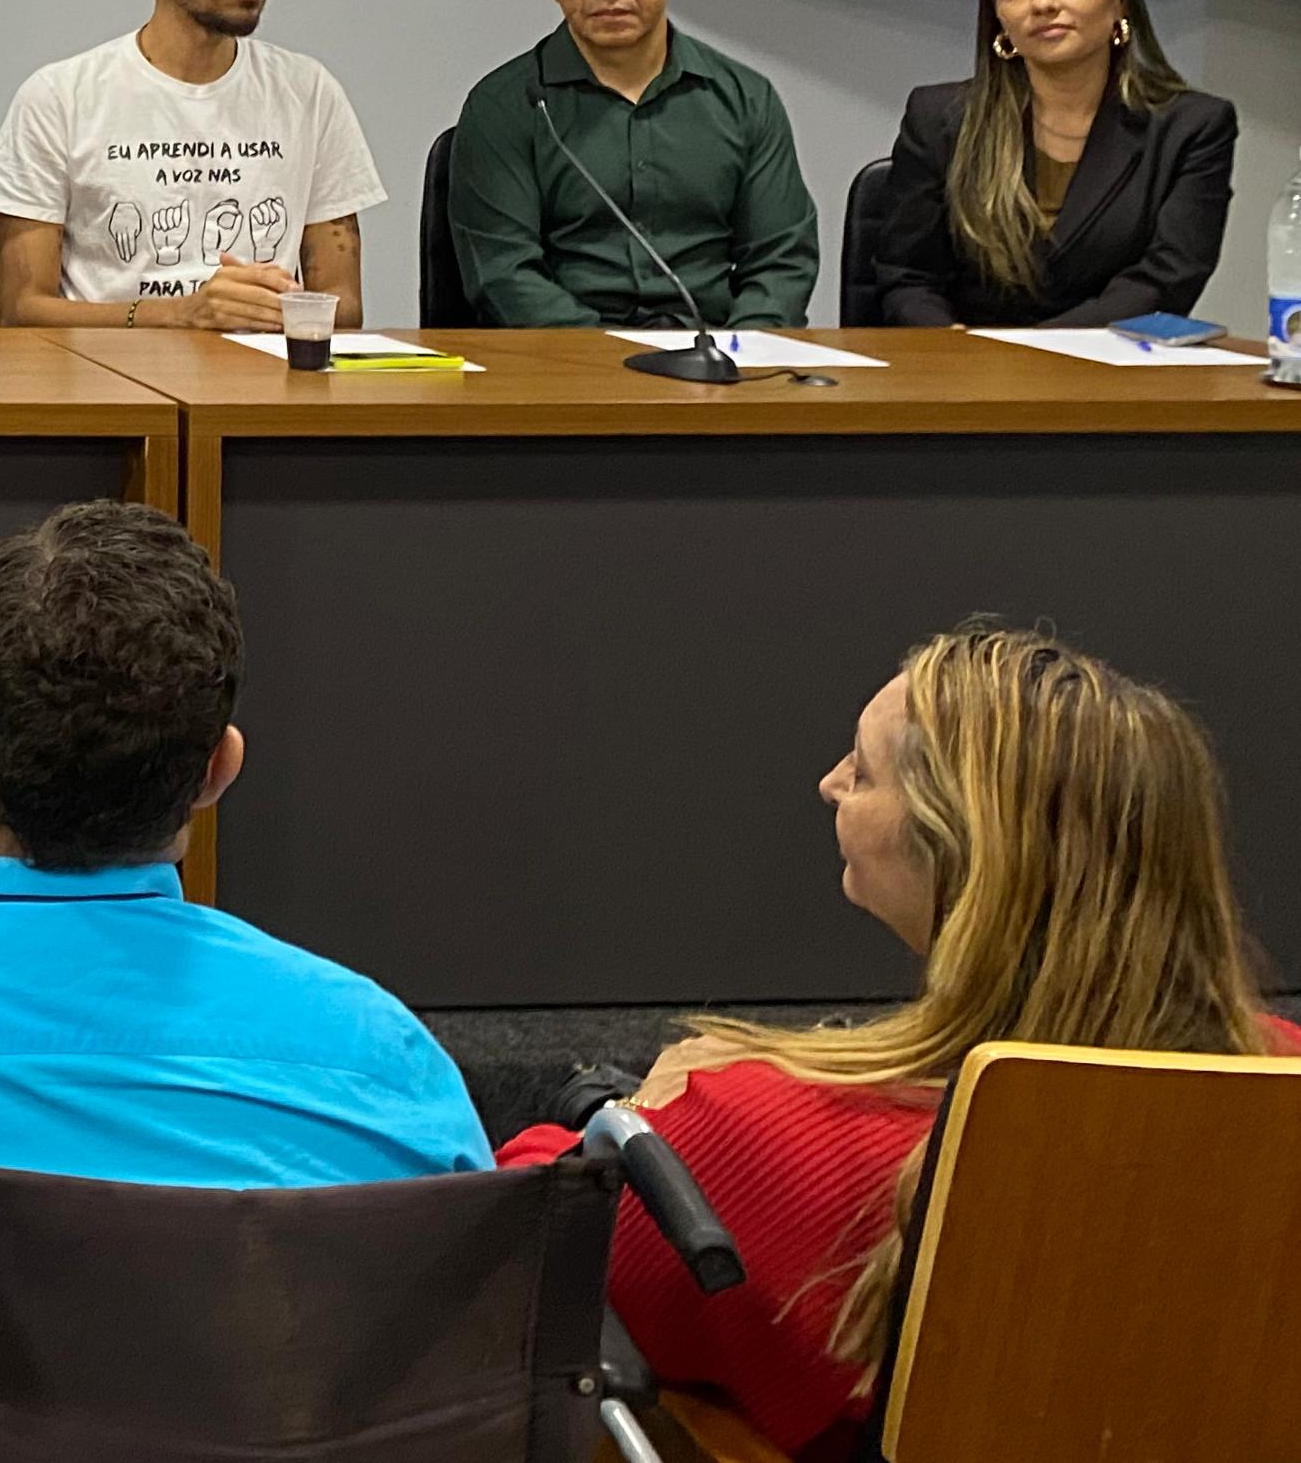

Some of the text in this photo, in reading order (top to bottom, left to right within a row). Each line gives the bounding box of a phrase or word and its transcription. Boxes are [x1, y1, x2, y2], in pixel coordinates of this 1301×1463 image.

[107, 141, 284, 161] EU APRENDI A USAR
[156, 168, 242, 186] A VOZ NAS
[139, 280, 184, 297] PARA
